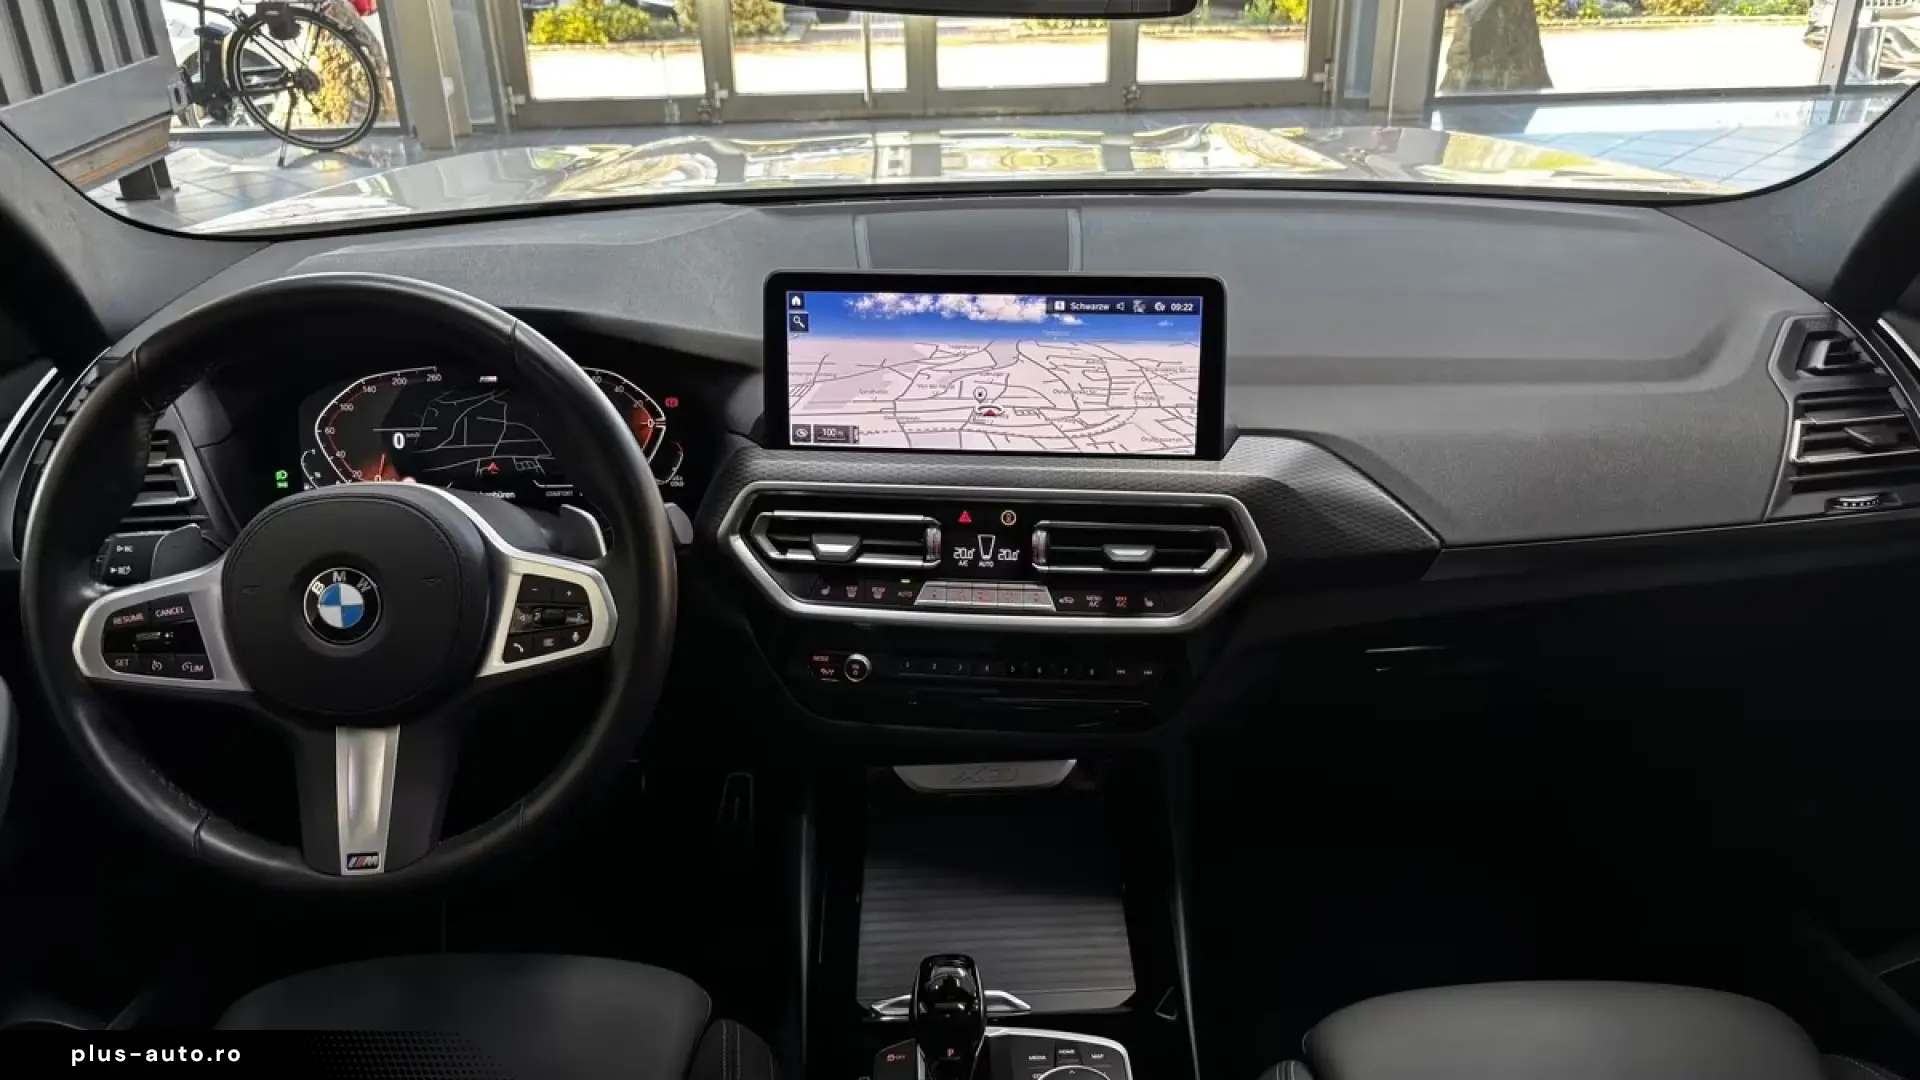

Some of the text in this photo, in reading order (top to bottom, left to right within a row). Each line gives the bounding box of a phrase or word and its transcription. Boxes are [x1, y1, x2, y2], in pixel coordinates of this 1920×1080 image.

[1171, 303, 1194, 311] 09:22
[392, 377, 407, 386] 200
[427, 373, 442, 382] 260
[363, 385, 376, 393] 140
[340, 403, 354, 411] 100
[325, 426, 335, 434] 60
[822, 428, 836, 437] 100
[393, 432, 405, 448] 0
[155, 606, 184, 617] CANCEL
[113, 613, 144, 624] RESUME
[115, 658, 128, 667] SET
[190, 664, 204, 672] LIM
